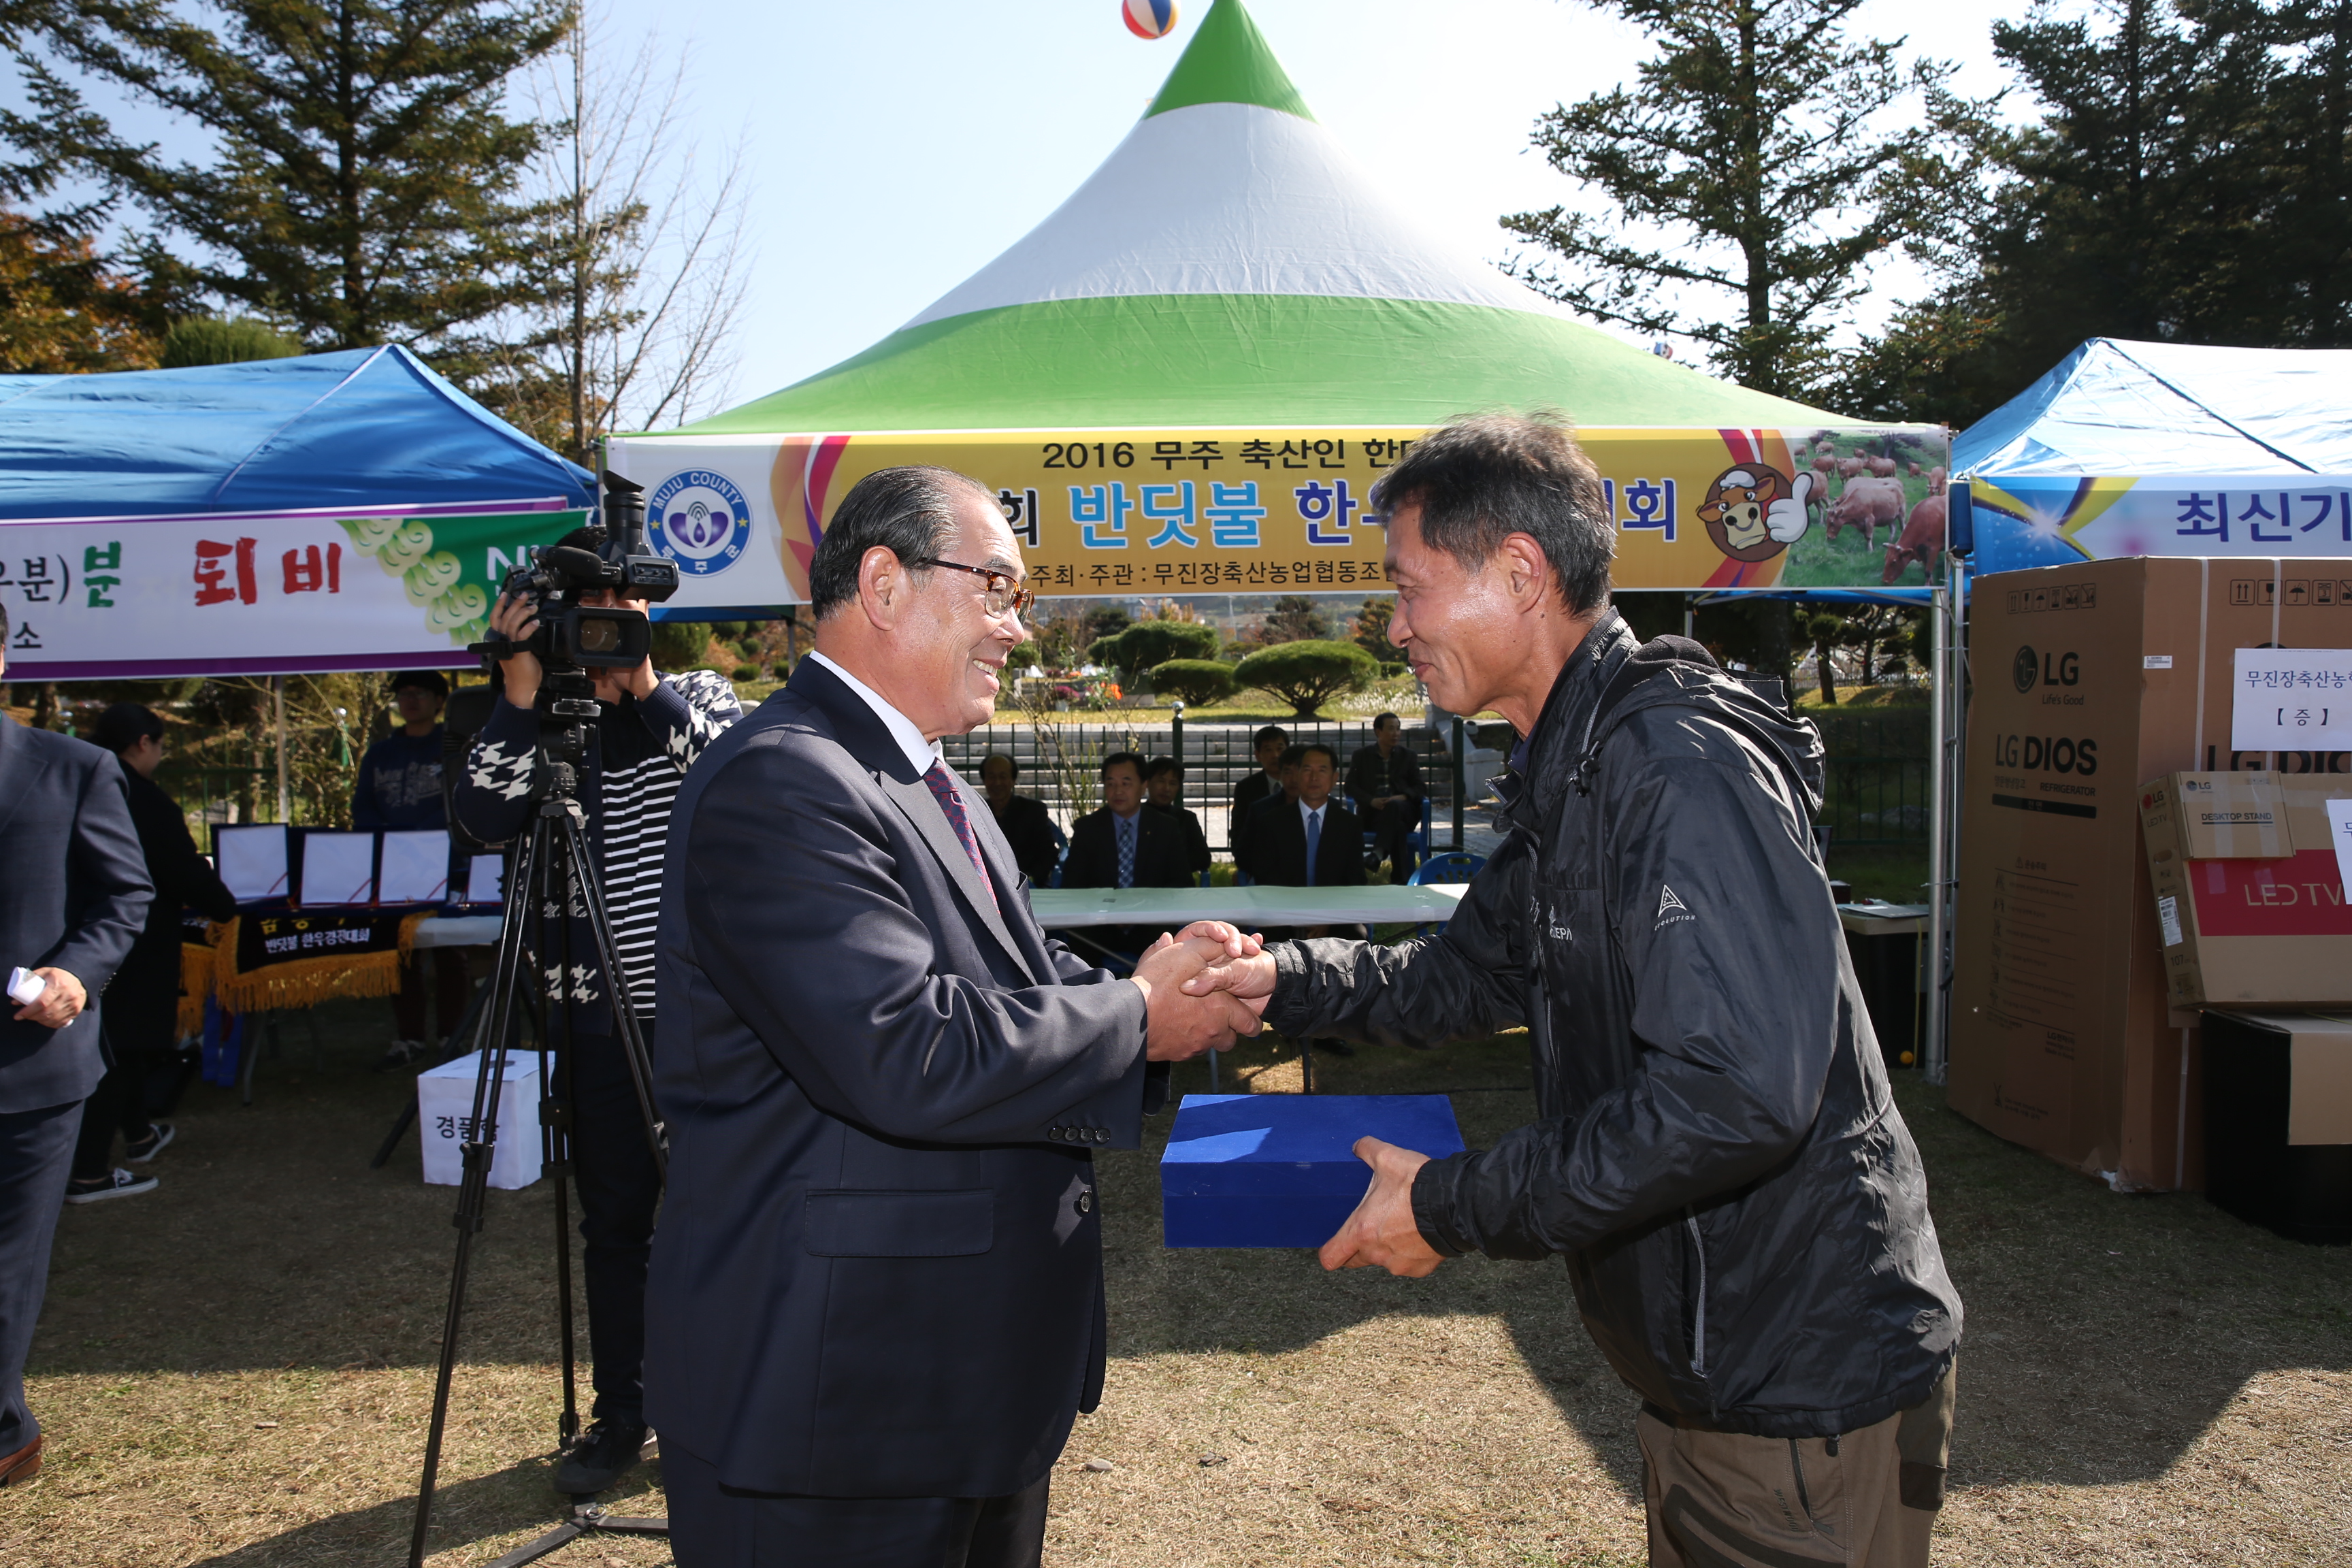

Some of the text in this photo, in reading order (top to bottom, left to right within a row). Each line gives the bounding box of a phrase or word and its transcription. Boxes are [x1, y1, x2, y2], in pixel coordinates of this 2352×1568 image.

[1043, 439, 1413, 470] 2016 무주 축산인 한
[653, 472, 743, 510] MUJU COUNTY
[1068, 480, 1267, 547] 반딧불
[1153, 561, 1393, 586] 무진장축산농업협동조
[2044, 652, 2079, 685] LG
[2244, 670, 2352, 689] 무진장축산농
[2042, 693, 2084, 705] Life's Good
[1995, 734, 2097, 776] LG DIOS
[2040, 783, 2096, 796] REFRIGERATOR
[2198, 781, 2211, 790] LG
[2153, 791, 2164, 803] LG
[2202, 813, 2241, 821] DESKTOP
[2244, 883, 2341, 906] LED TV
[2170, 954, 2183, 966] 107
